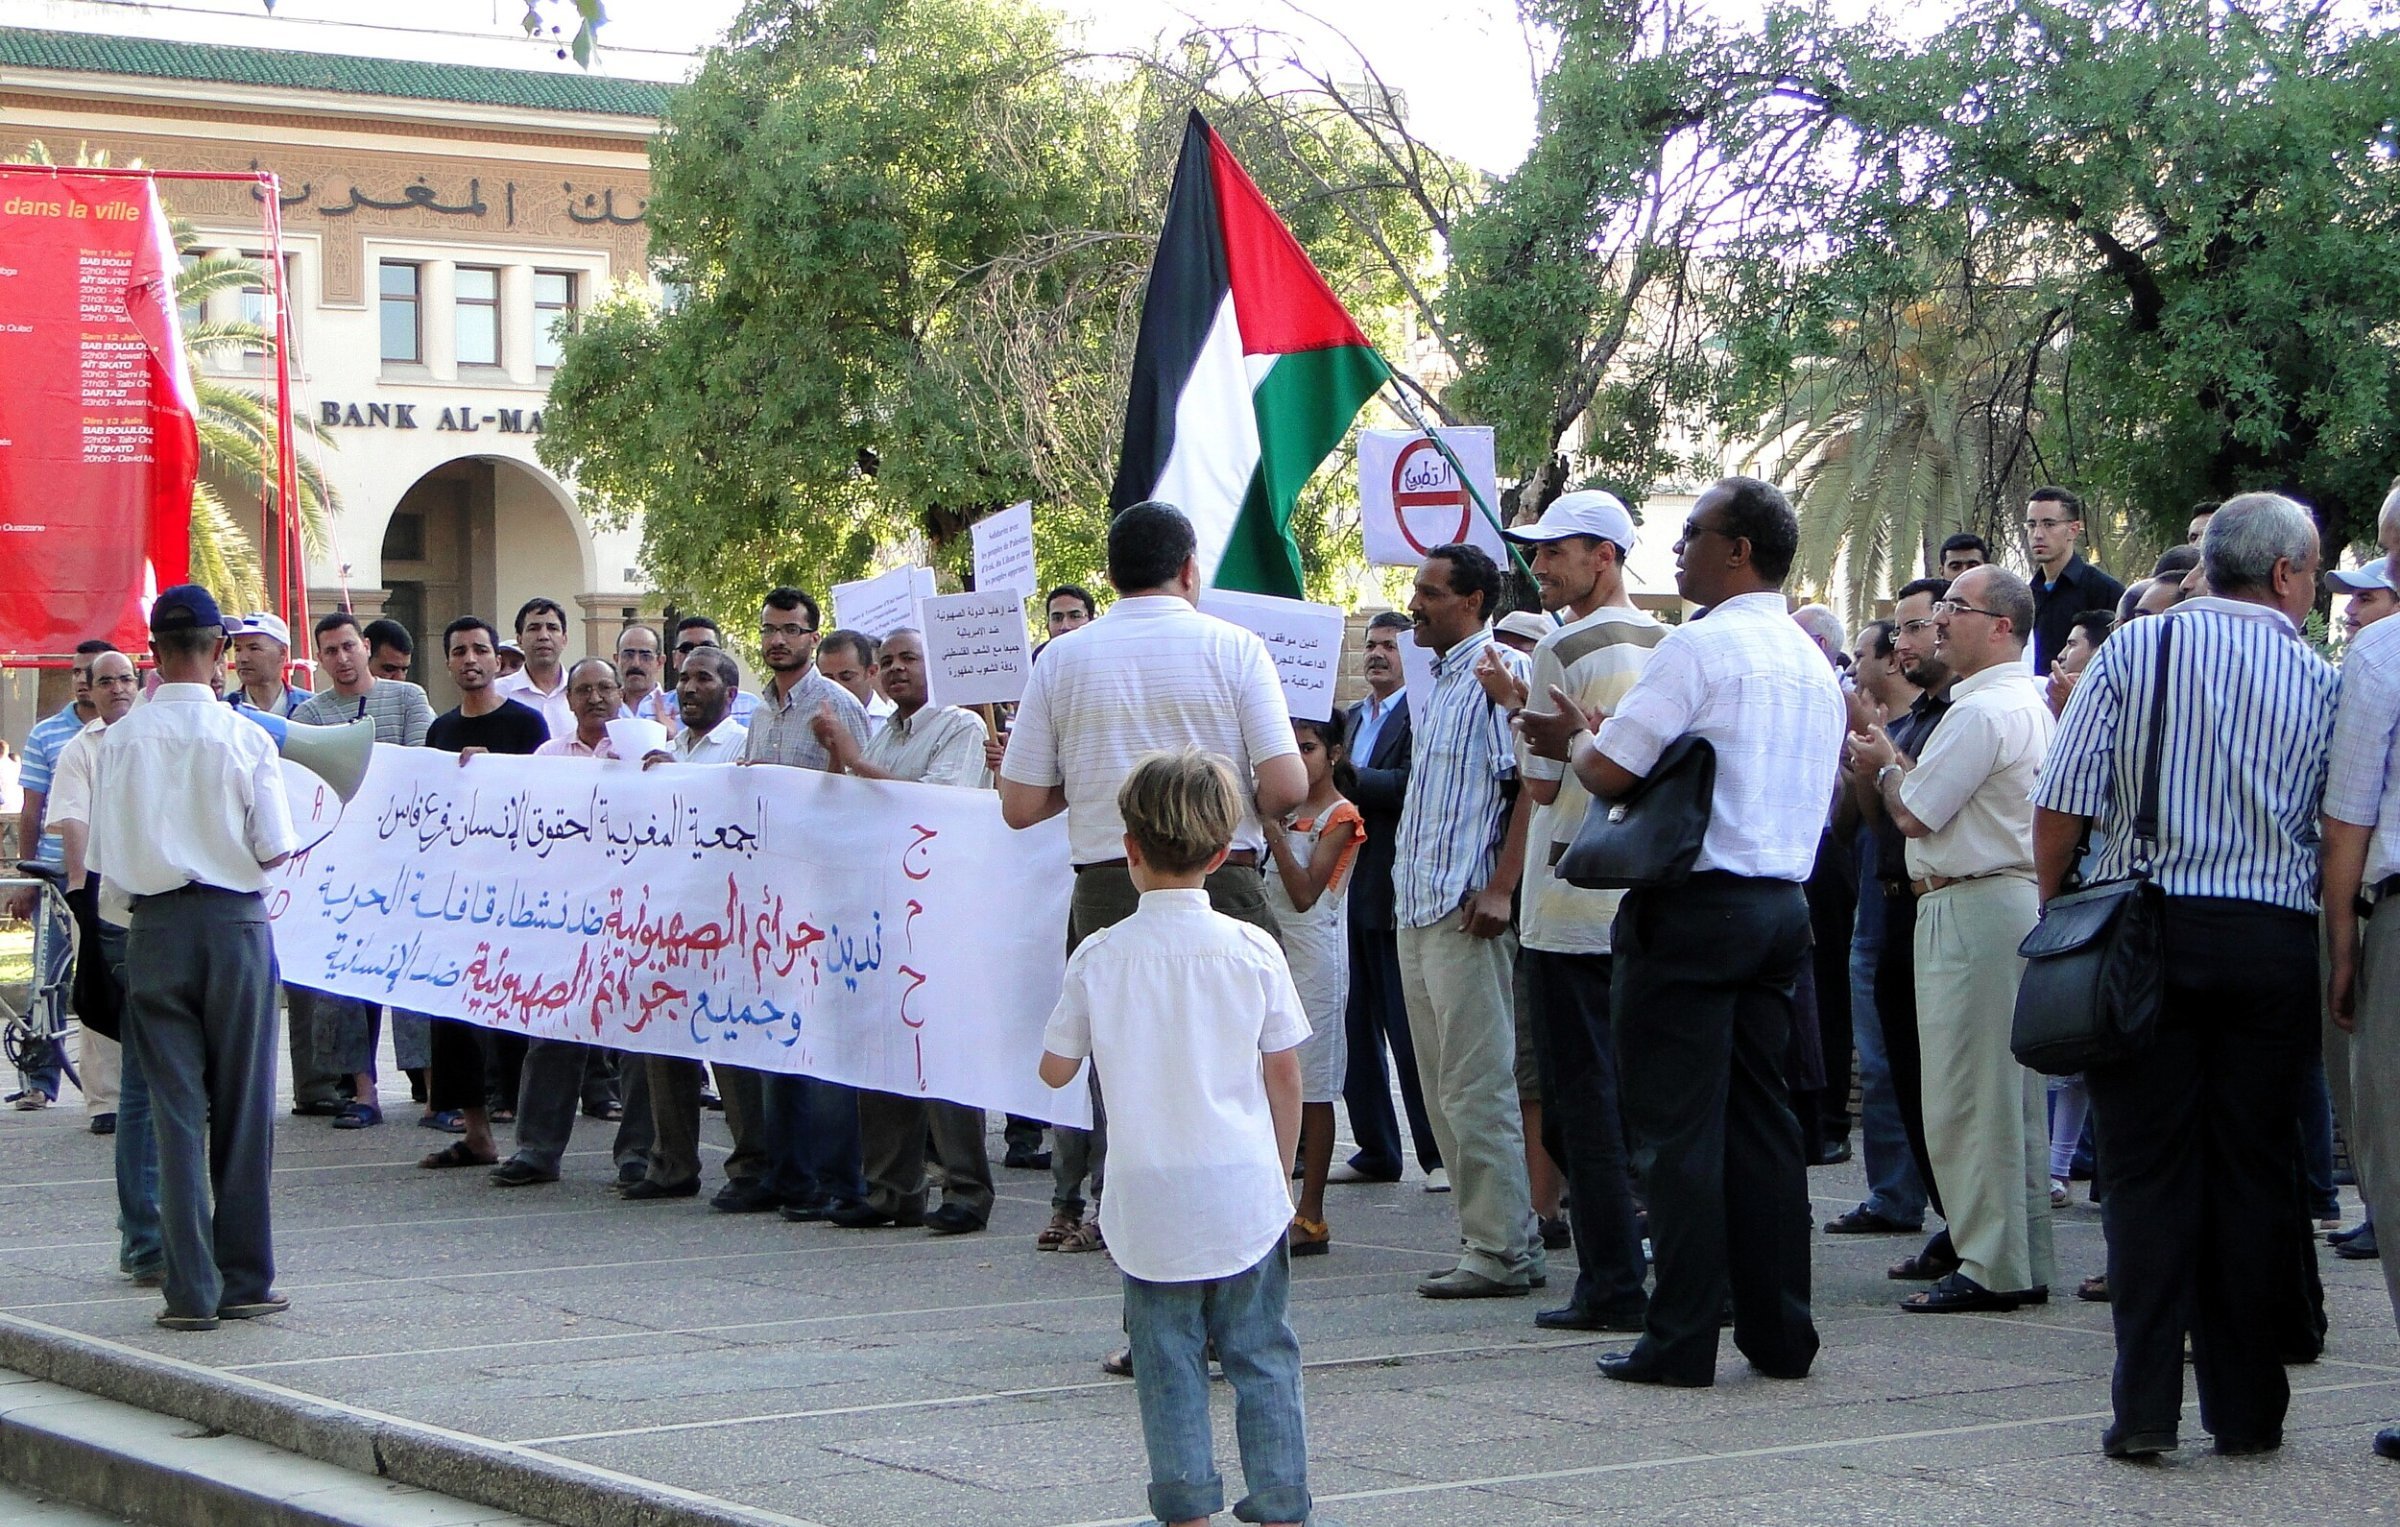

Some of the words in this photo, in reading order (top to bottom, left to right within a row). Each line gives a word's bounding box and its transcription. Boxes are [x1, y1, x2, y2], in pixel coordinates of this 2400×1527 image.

[5, 196, 61, 217] dans
[68, 200, 88, 218] la
[95, 202, 140, 221] ville
[564, 180, 647, 226] نك
[80, 257, 100, 266] BAB
[81, 305, 101, 313] DAR
[104, 306, 125, 314] TAZI
[81, 342, 102, 351] BAB
[99, 361, 132, 369] SKATO
[82, 390, 103, 398] DAR
[106, 390, 127, 398] TAZI
[83, 426, 104, 435] BAB
[320, 401, 418, 429] BANK
[436, 406, 546, 434] AL-MA
[101, 446, 134, 454] SKATO
[1405, 461, 1451, 491] التطبيع
[527, 784, 598, 859] لحقوق
[600, 793, 682, 866] المغربية
[689, 796, 768, 860] الجمعية
[318, 864, 410, 924] الحرية
[411, 870, 497, 924] قافلة
[565, 898, 605, 936] ضد
[827, 911, 881, 993] ندين
[410, 953, 460, 987] ضد
[691, 988, 802, 1047] وجميع
